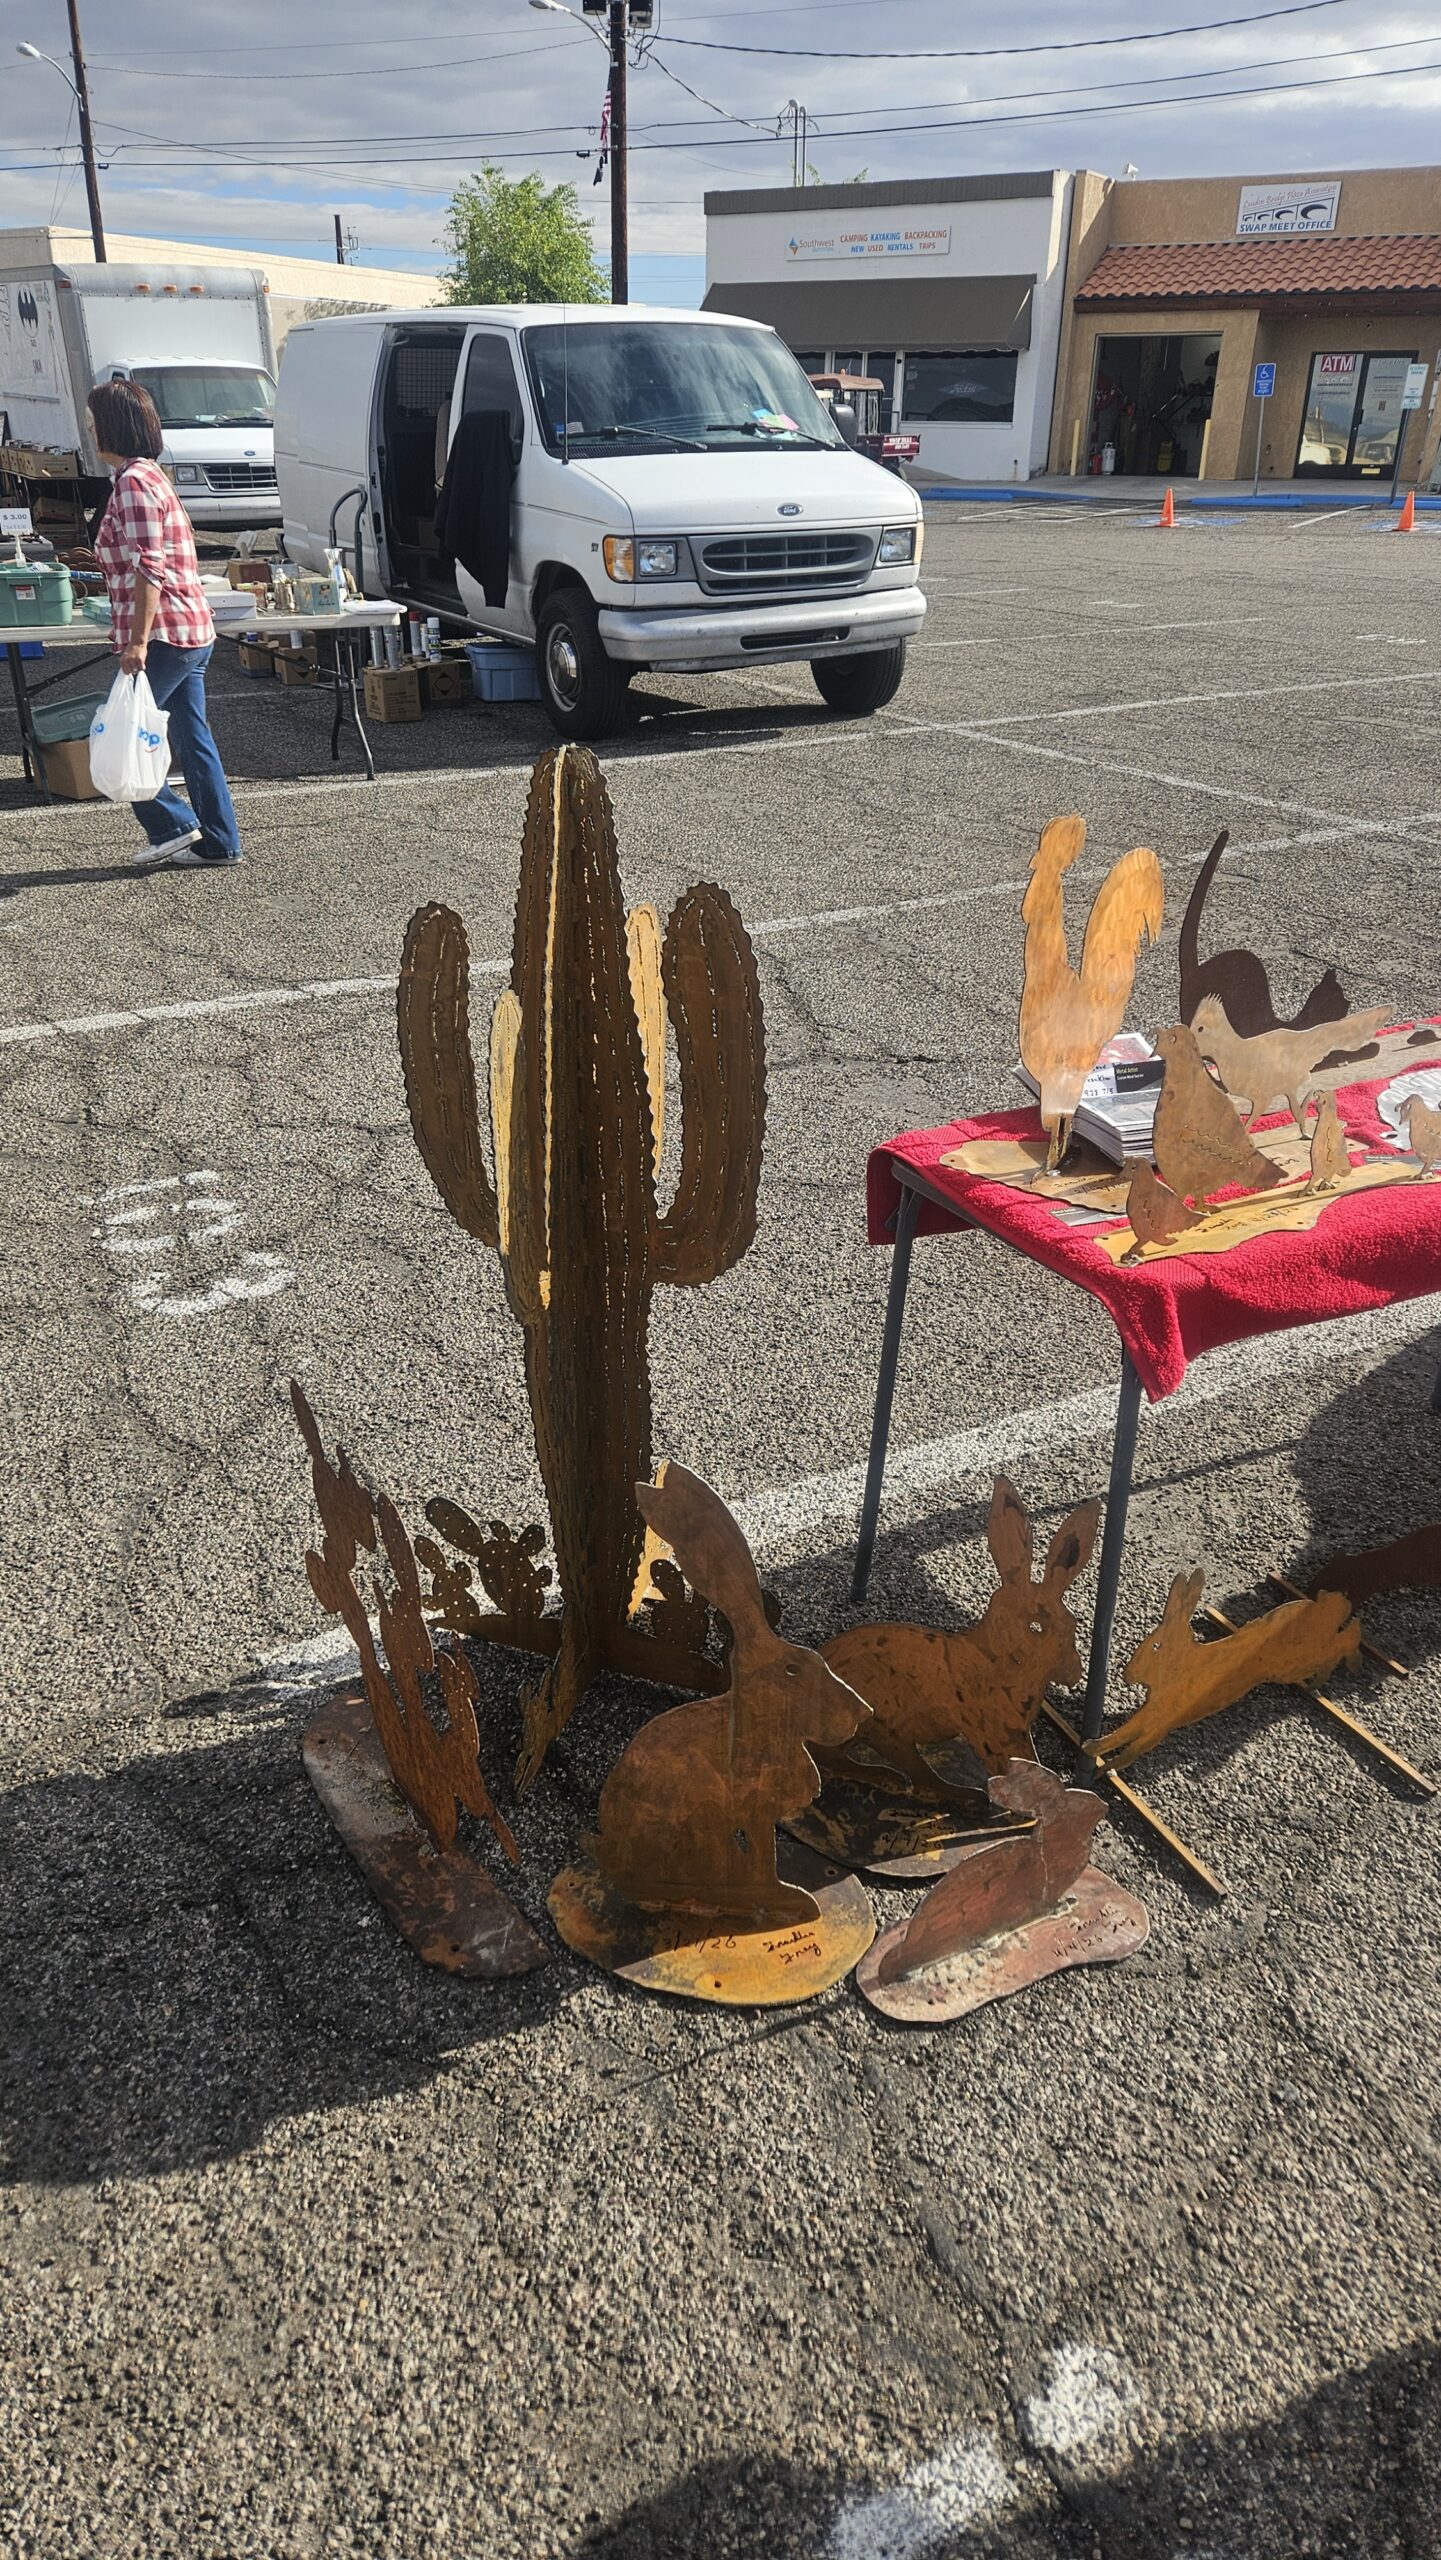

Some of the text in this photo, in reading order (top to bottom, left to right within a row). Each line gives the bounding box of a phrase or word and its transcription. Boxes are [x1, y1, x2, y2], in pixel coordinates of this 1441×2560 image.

[1240, 220, 1333, 232] SWAP MEET OFFICE
[840, 229, 947, 243] CAMPING KAYAKING BACKPACKING
[799, 239, 834, 248] Southwest
[850, 242, 936, 253] NEW USED RENTALS TRIPS
[1321, 355, 1354, 372] ATM
